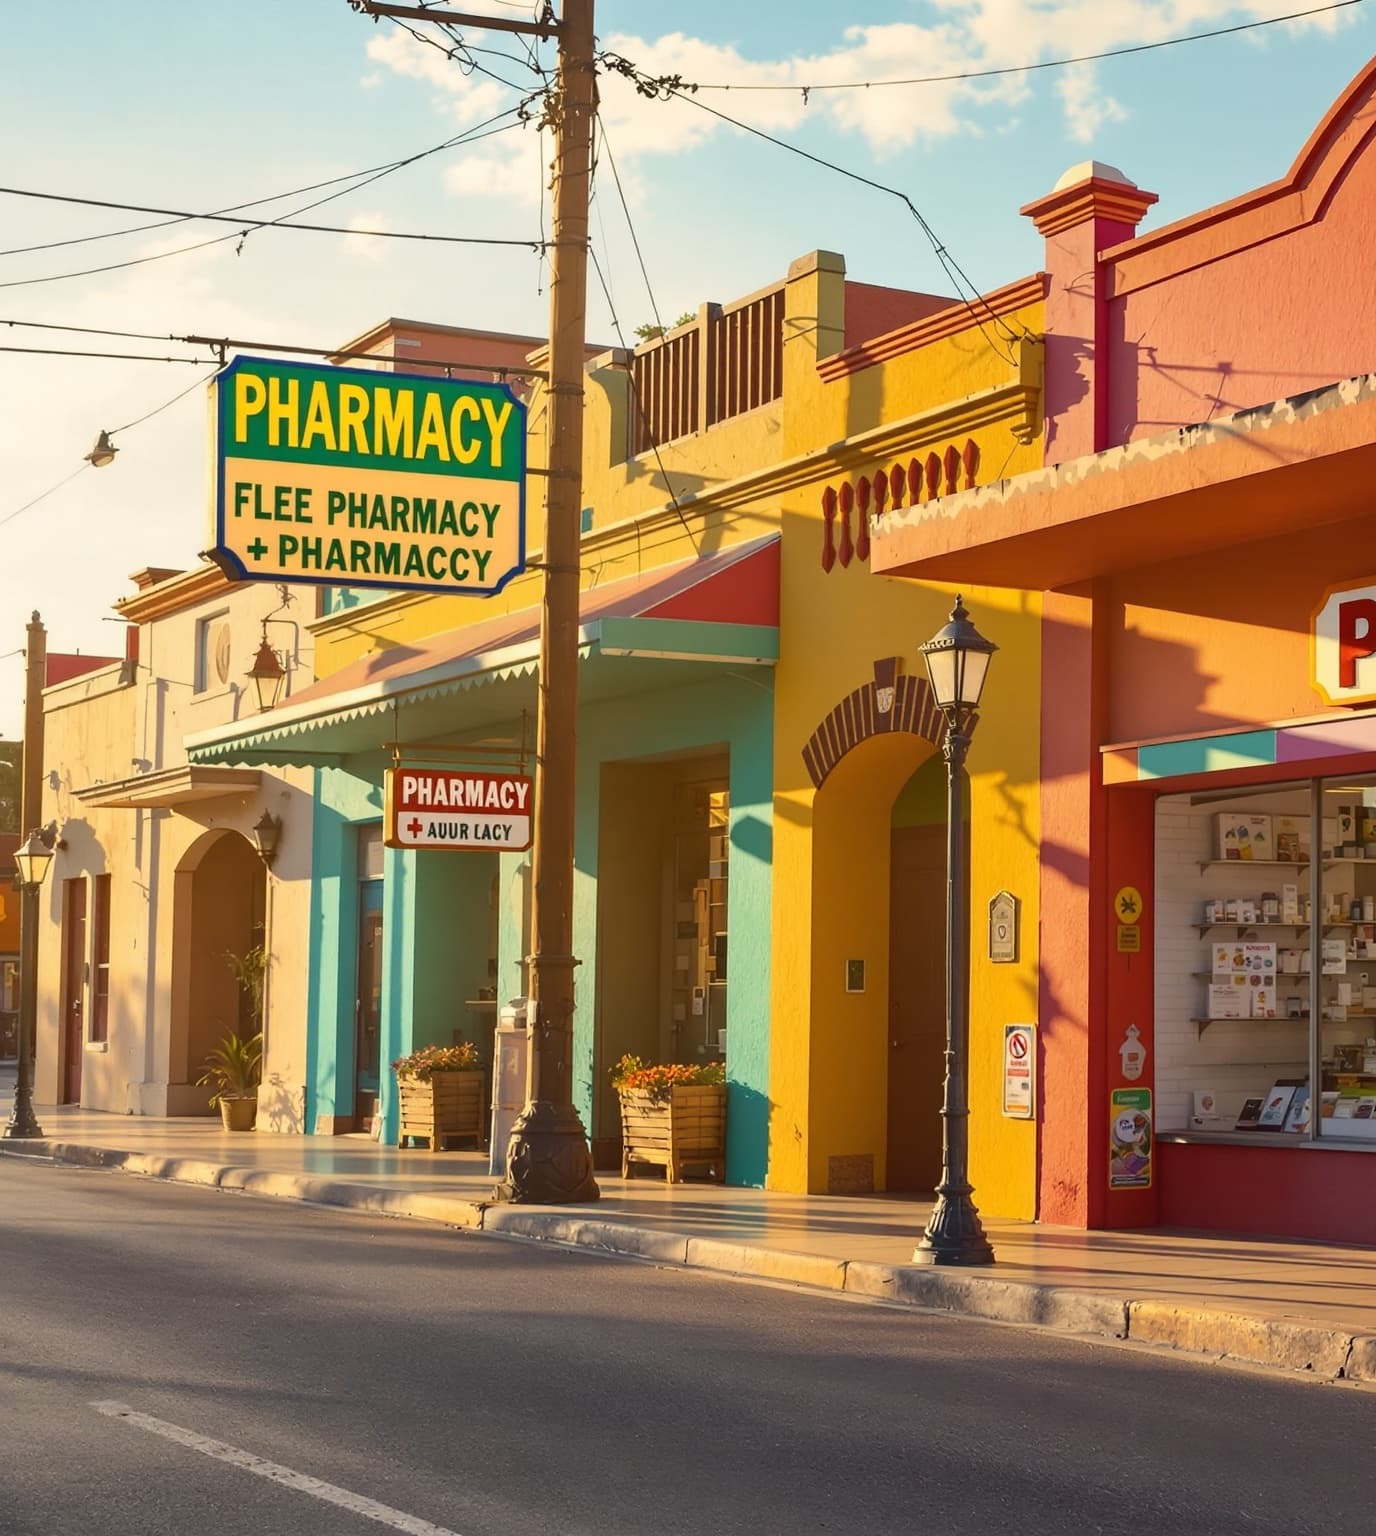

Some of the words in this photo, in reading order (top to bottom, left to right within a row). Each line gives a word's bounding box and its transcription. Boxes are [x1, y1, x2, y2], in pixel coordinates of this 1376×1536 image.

[234, 372, 513, 468] PHARMACY
[233, 481, 314, 524] FLEE
[327, 490, 501, 539] PHARMACY
[278, 534, 493, 582] PHARMACCY
[402, 776, 529, 810] PHARMACY
[427, 821, 469, 840] AUUR
